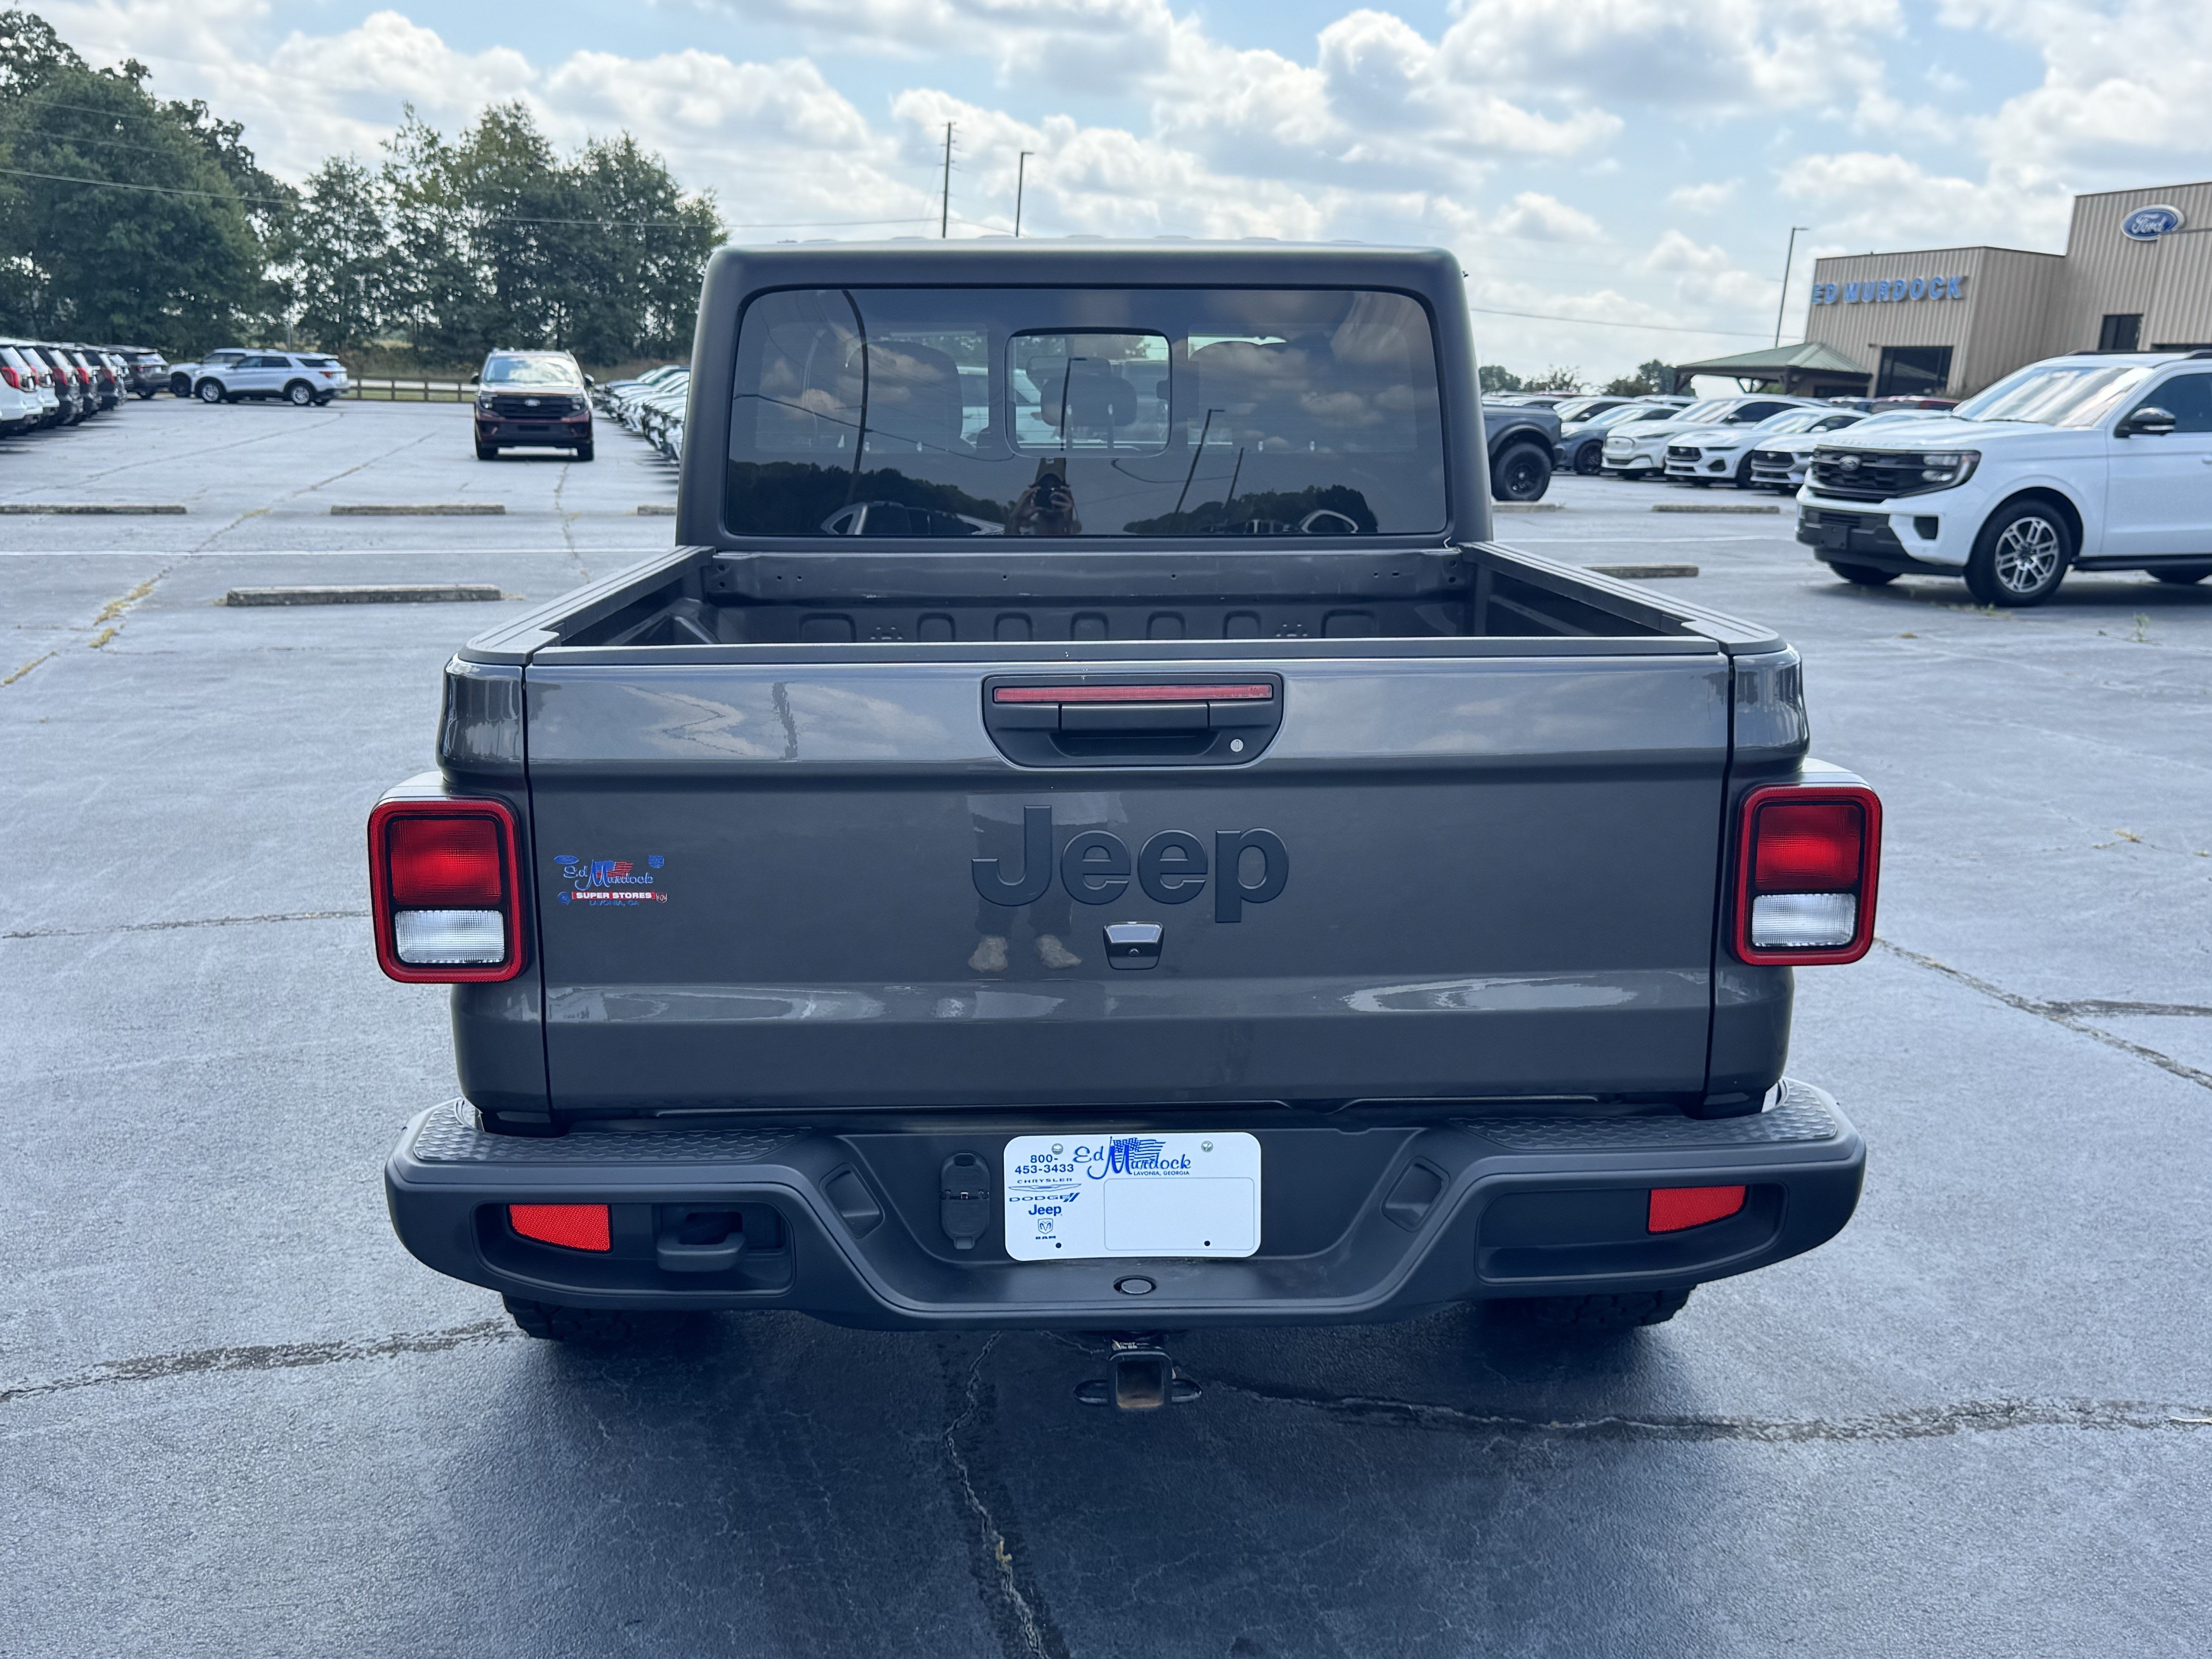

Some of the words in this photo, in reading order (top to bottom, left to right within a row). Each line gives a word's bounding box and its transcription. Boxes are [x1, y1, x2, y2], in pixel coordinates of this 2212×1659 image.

[2131, 213, 2167, 234] Ford
[1812, 283, 1837, 304] ED
[1844, 275, 1961, 303] MURDOCK
[563, 866, 588, 878] Ed
[972, 805, 1289, 923] Jeep
[575, 860, 654, 891] Murdock
[1030, 1154, 1058, 1163] 800-
[1072, 1146, 1104, 1163] Ed
[1087, 1145, 1192, 1180] Murdock
[1015, 1164, 1074, 1175] 453-3433
[1009, 1194, 1070, 1202] DODGE
[1028, 1204, 1062, 1216] Jeep
